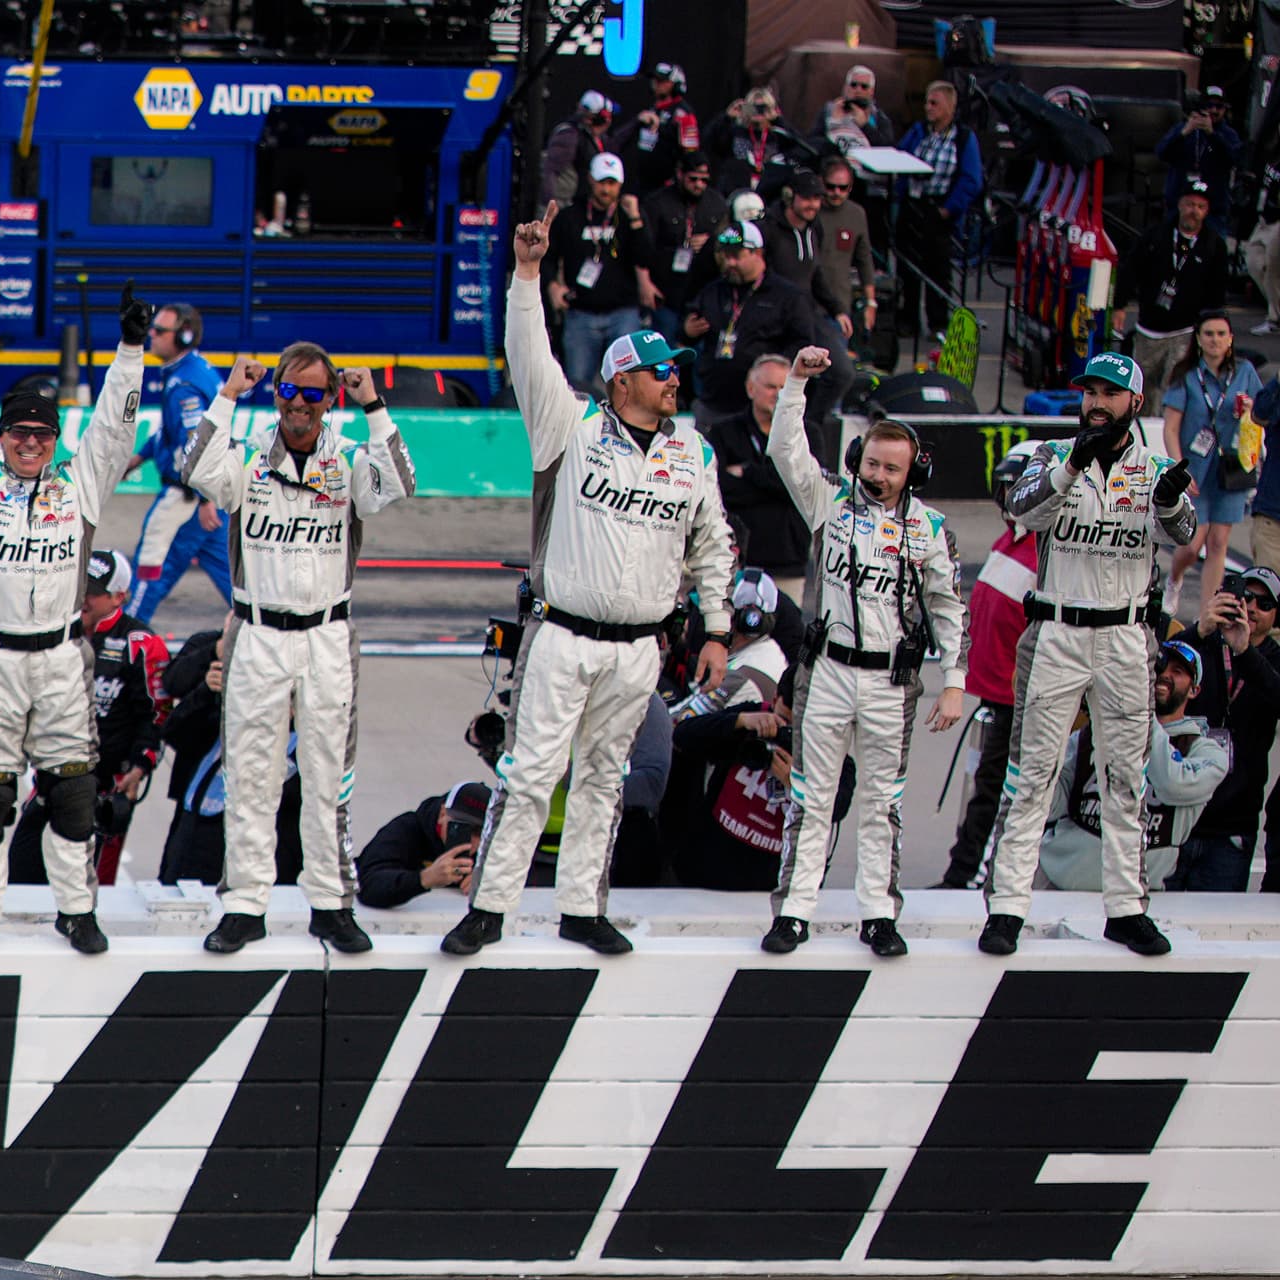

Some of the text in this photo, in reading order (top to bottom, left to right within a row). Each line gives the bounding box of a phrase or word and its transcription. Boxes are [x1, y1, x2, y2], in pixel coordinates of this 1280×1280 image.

[145, 87, 193, 113] NAPA
[463, 69, 502, 100] 9
[580, 471, 689, 523] UniFirst
[245, 511, 344, 544] UniFirst
